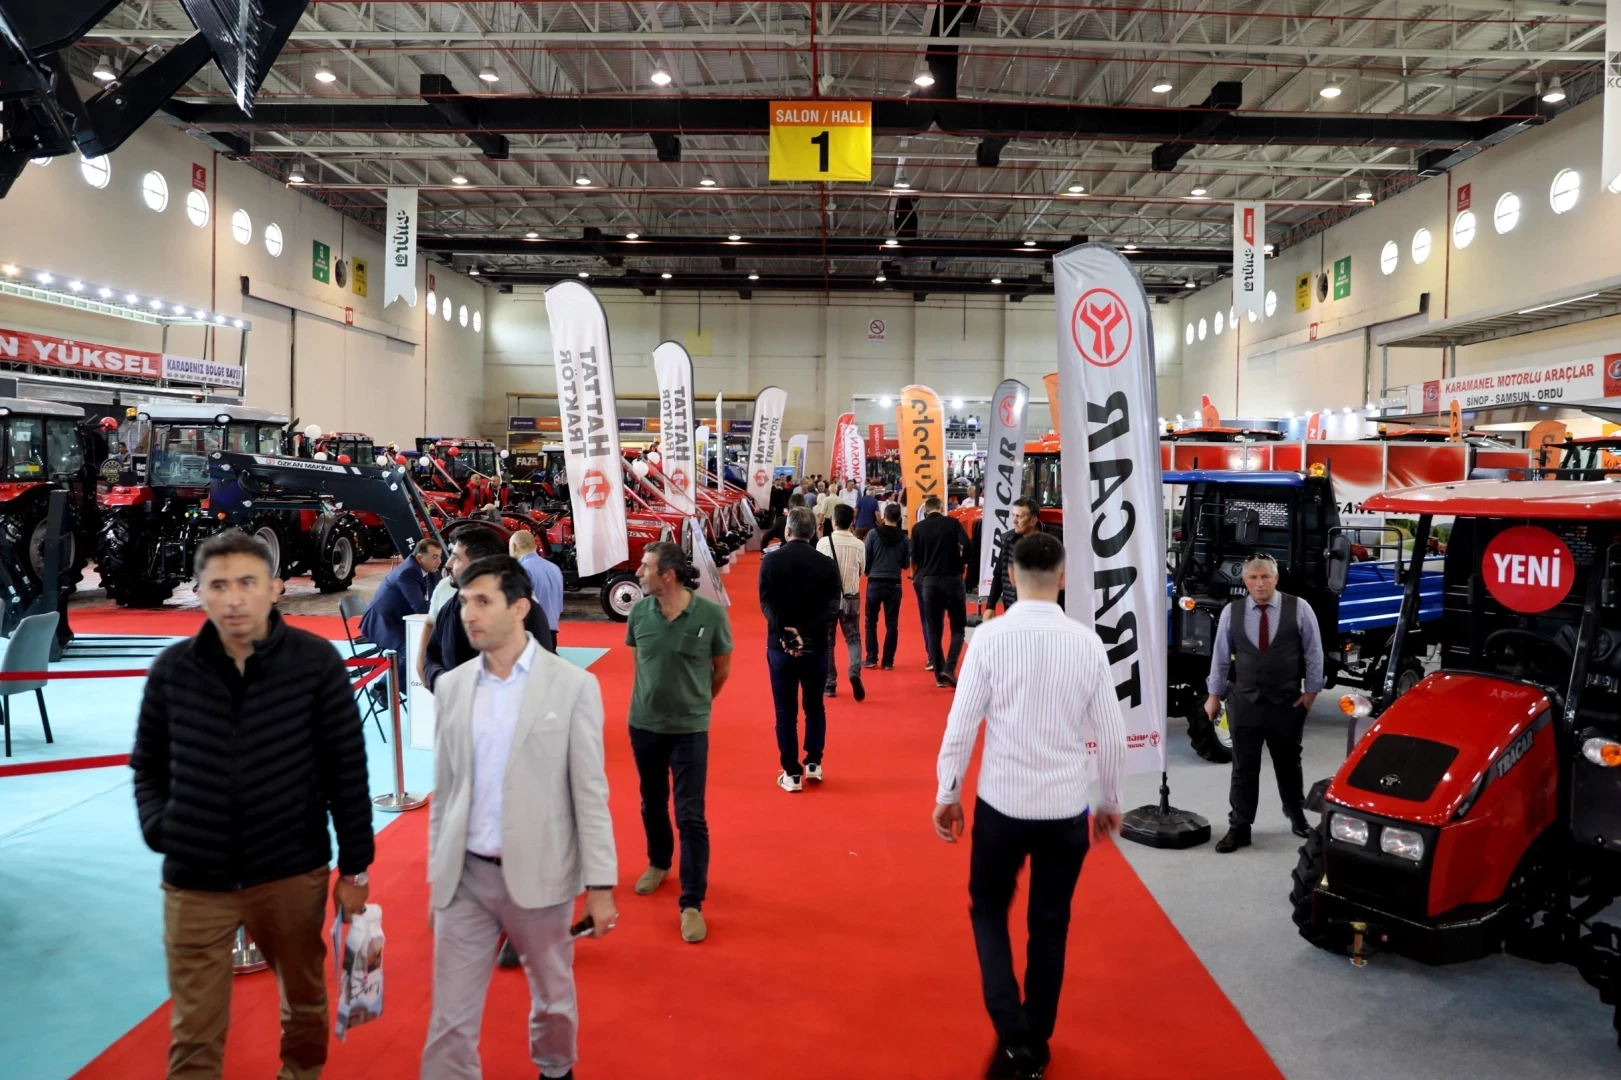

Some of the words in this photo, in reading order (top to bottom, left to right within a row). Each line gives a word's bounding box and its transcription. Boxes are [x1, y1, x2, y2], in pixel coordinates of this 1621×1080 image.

[776, 109, 819, 123] SALON
[823, 110, 829, 124] /
[831, 109, 865, 123] HALL
[811, 131, 829, 172] 1
[32, 340, 157, 374] YÜKSEL
[167, 359, 204, 375] KARADENİZ
[1445, 377, 1495, 393] KARAMANEL
[1497, 371, 1542, 387] MOTORLU
[1545, 363, 1594, 383] ARAÇLAR
[1466, 392, 1489, 406] SİNOP
[1495, 391, 1530, 404] SAMSUN
[1537, 387, 1564, 399] ORDU
[754, 415, 769, 464] HATTAT
[1493, 548, 1561, 588] YENİ
[1496, 729, 1534, 778] TRACAR
